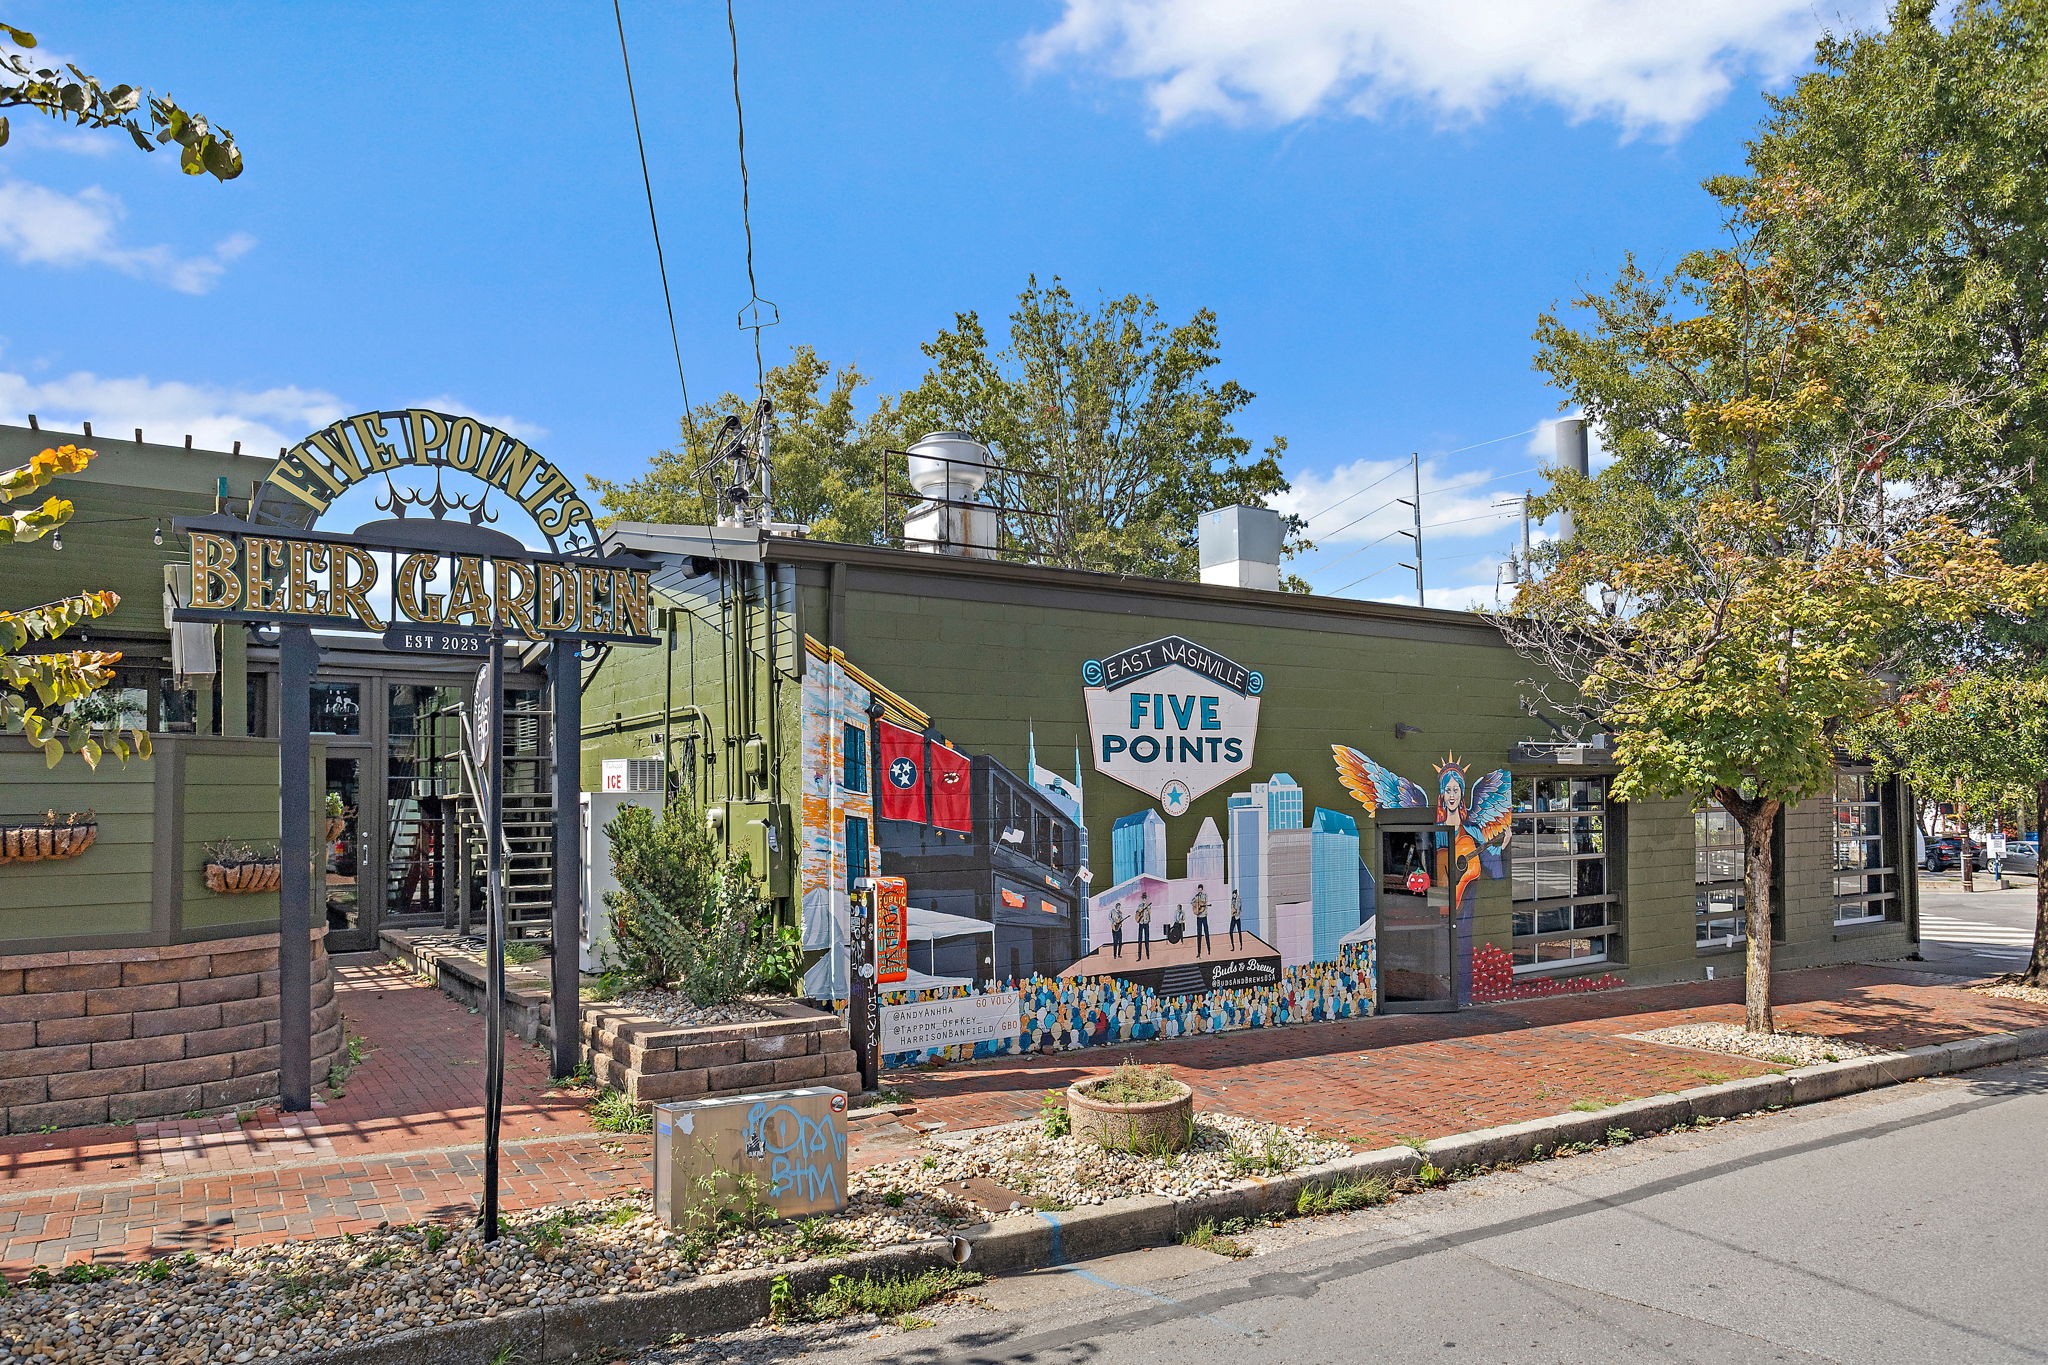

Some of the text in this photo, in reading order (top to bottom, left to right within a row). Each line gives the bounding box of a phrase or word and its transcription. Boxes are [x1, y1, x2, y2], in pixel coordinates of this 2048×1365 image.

[266, 409, 593, 538] FIVE POINTS
[188, 532, 653, 641] BEER GARDEN
[405, 635, 480, 652] EST 2023
[1106, 642, 1246, 690] EAST NASHVILLE
[1129, 692, 1222, 730] FIVE
[1102, 734, 1244, 763] POINTS
[607, 774, 622, 789] ICE
[1212, 958, 1276, 980] Buds & Brews
[975, 994, 1013, 1008] GO VOLS
[1001, 1020, 1018, 1031] GBO
